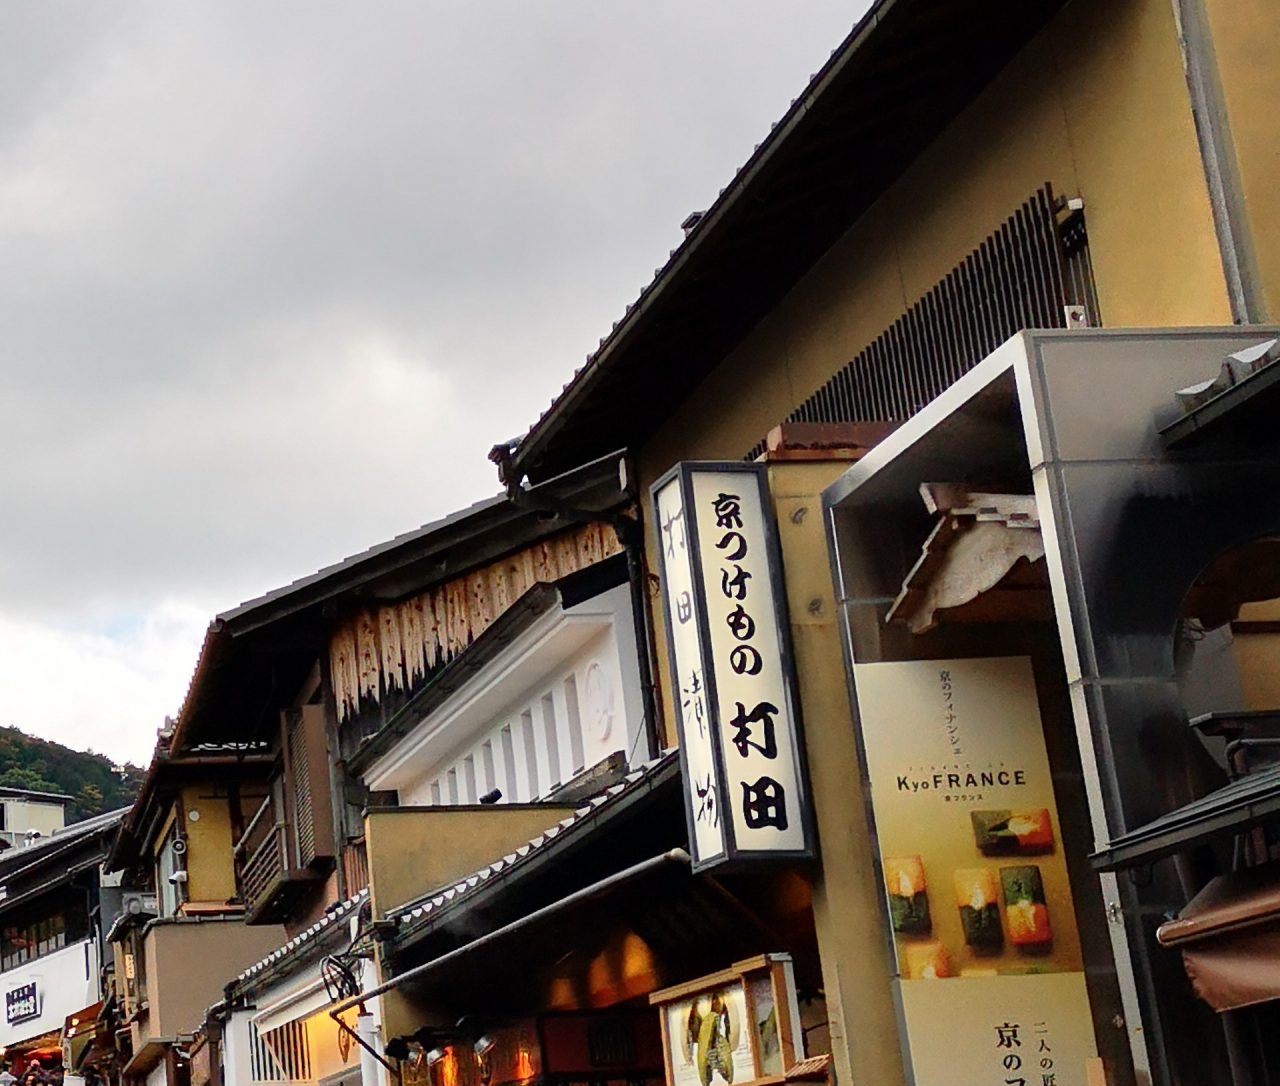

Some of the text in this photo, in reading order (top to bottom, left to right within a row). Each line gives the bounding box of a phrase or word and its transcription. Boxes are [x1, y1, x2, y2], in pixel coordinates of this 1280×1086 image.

[711, 492, 789, 832] 京つけもの 打田
[939, 669, 963, 756] 京のフィナンシェ
[896, 770, 1027, 792] KyoFRANCE
